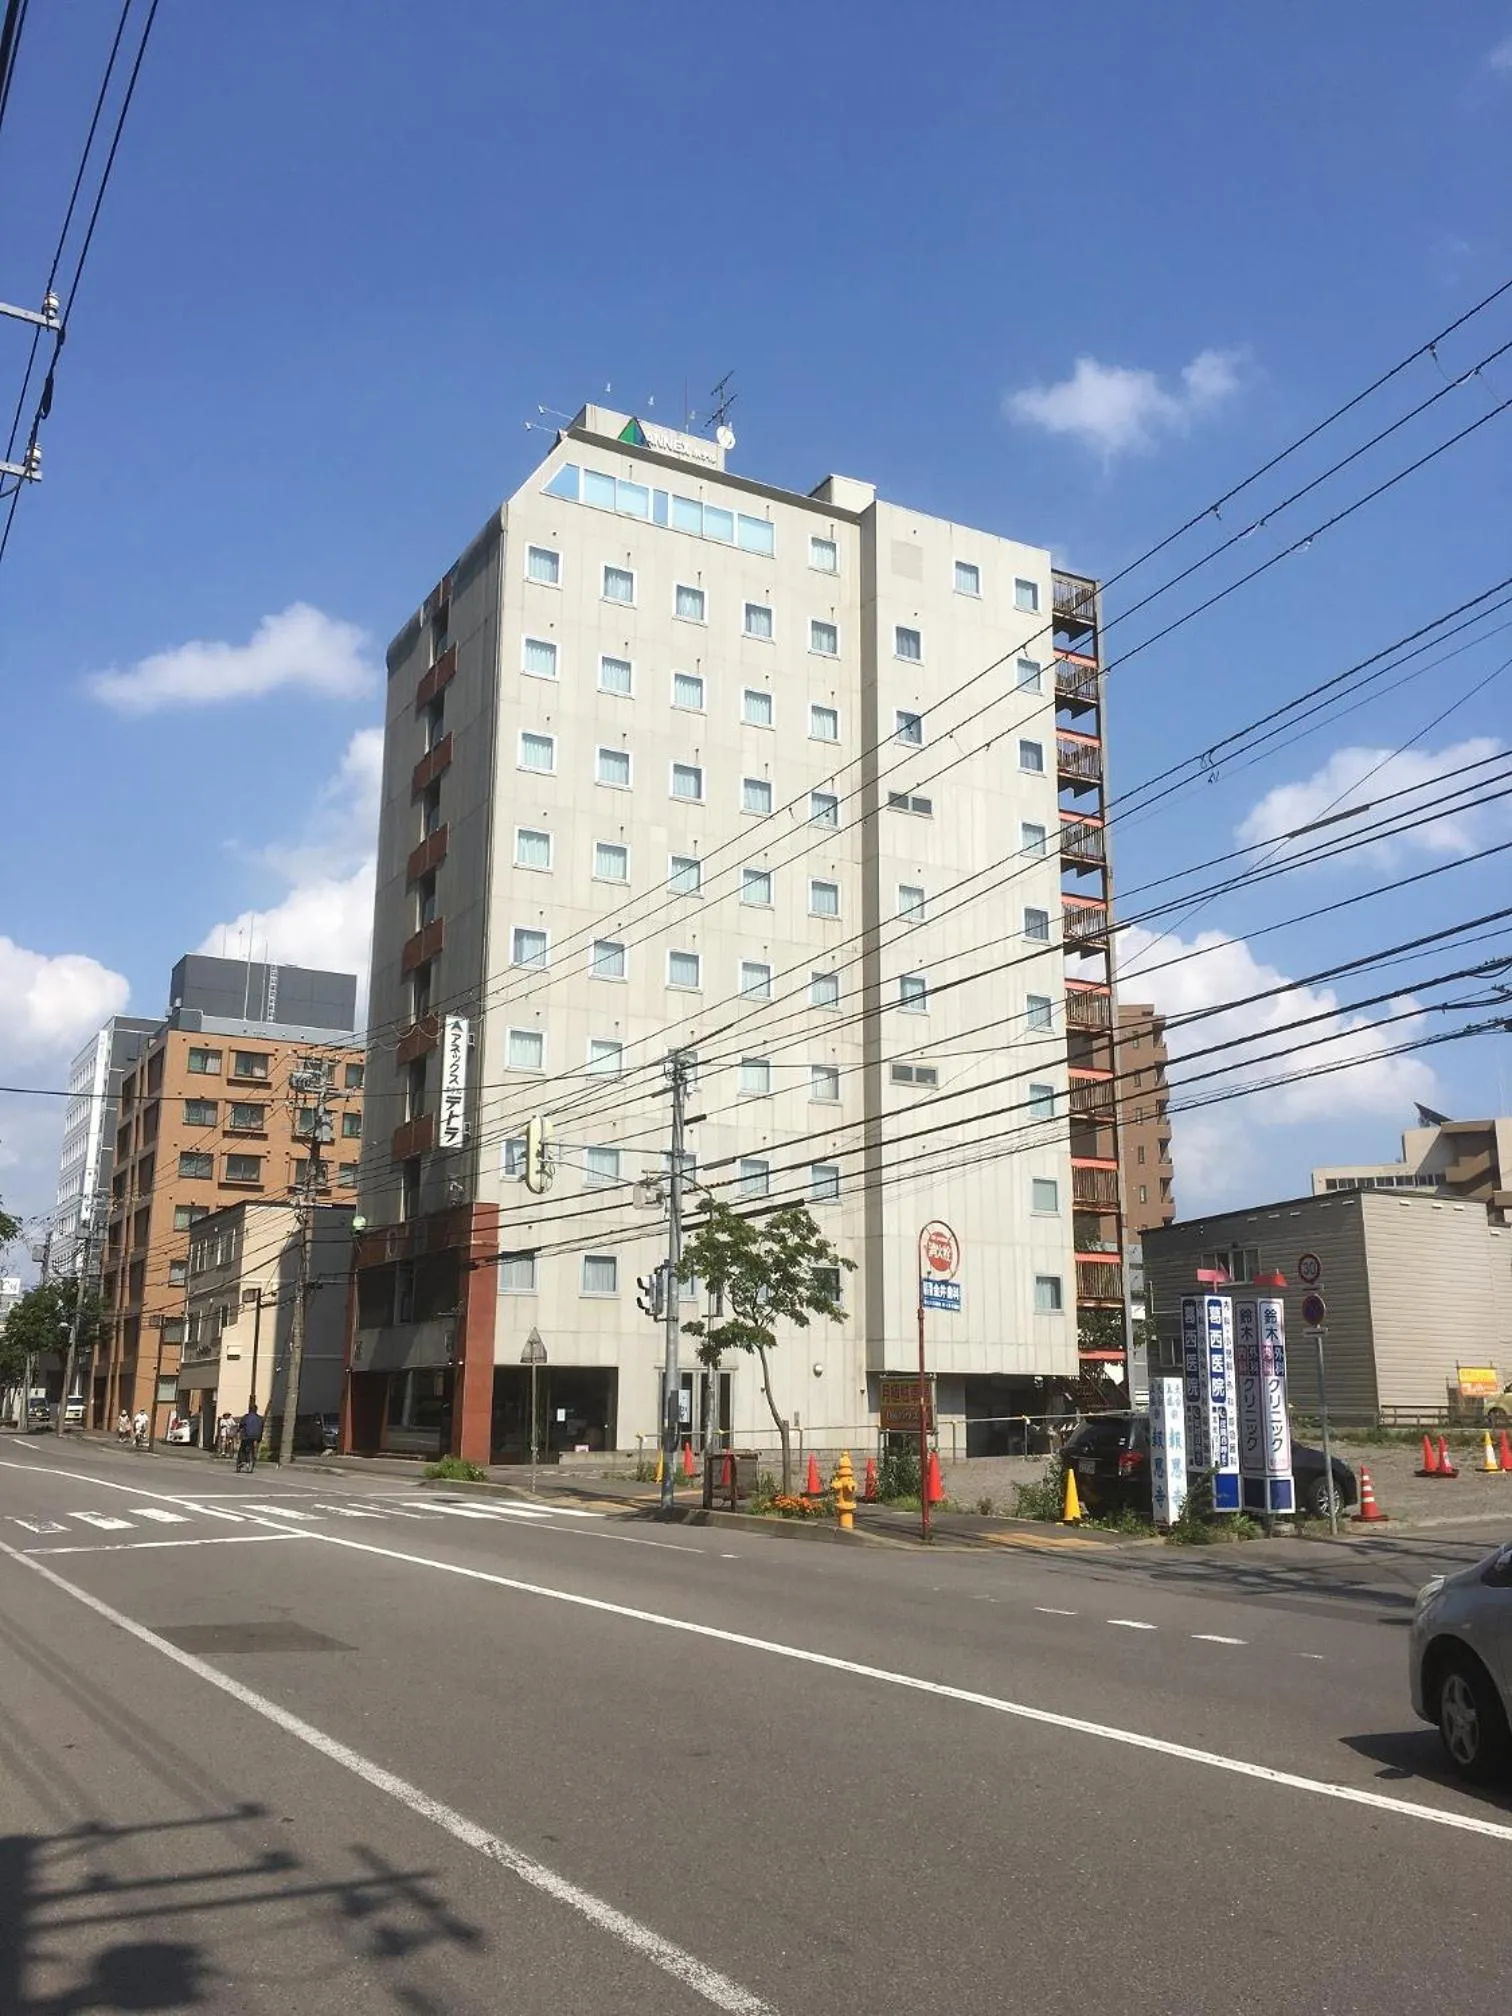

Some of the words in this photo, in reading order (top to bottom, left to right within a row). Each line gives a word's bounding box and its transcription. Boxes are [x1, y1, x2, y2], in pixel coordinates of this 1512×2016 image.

[448, 1032, 462, 1085] アネックス
[444, 1095, 462, 1143] テトラ
[1303, 1261, 1316, 1275] 30
[1268, 1378, 1283, 1453] クリニック
